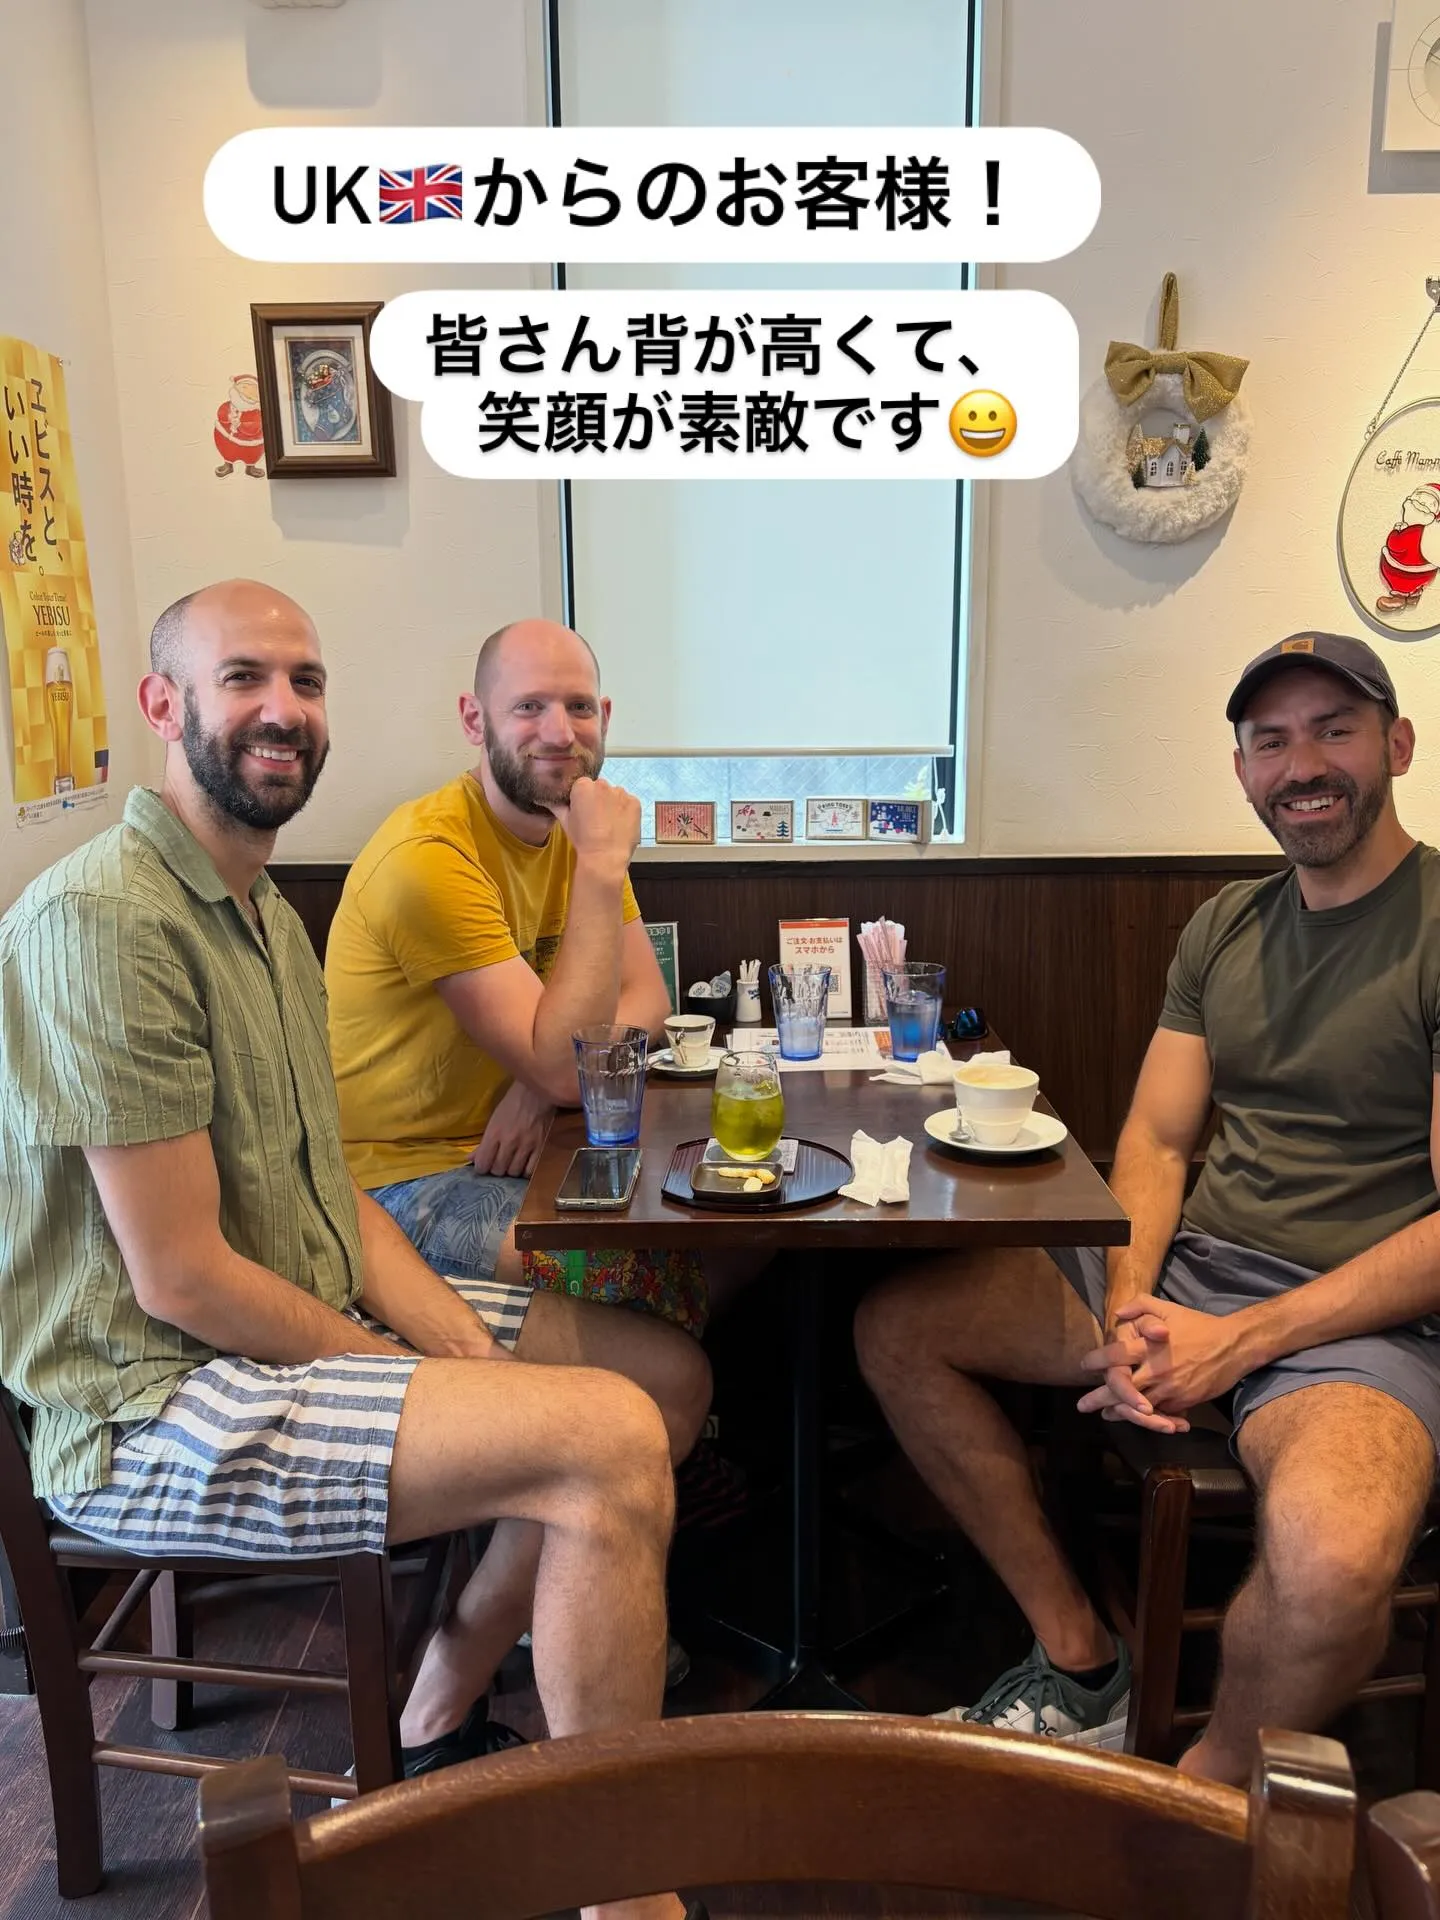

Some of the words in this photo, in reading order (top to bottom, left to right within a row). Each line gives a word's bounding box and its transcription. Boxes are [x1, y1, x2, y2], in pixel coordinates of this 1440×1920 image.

[32, 604, 71, 626] YEBISU
[794, 945, 835, 954] スマホから
